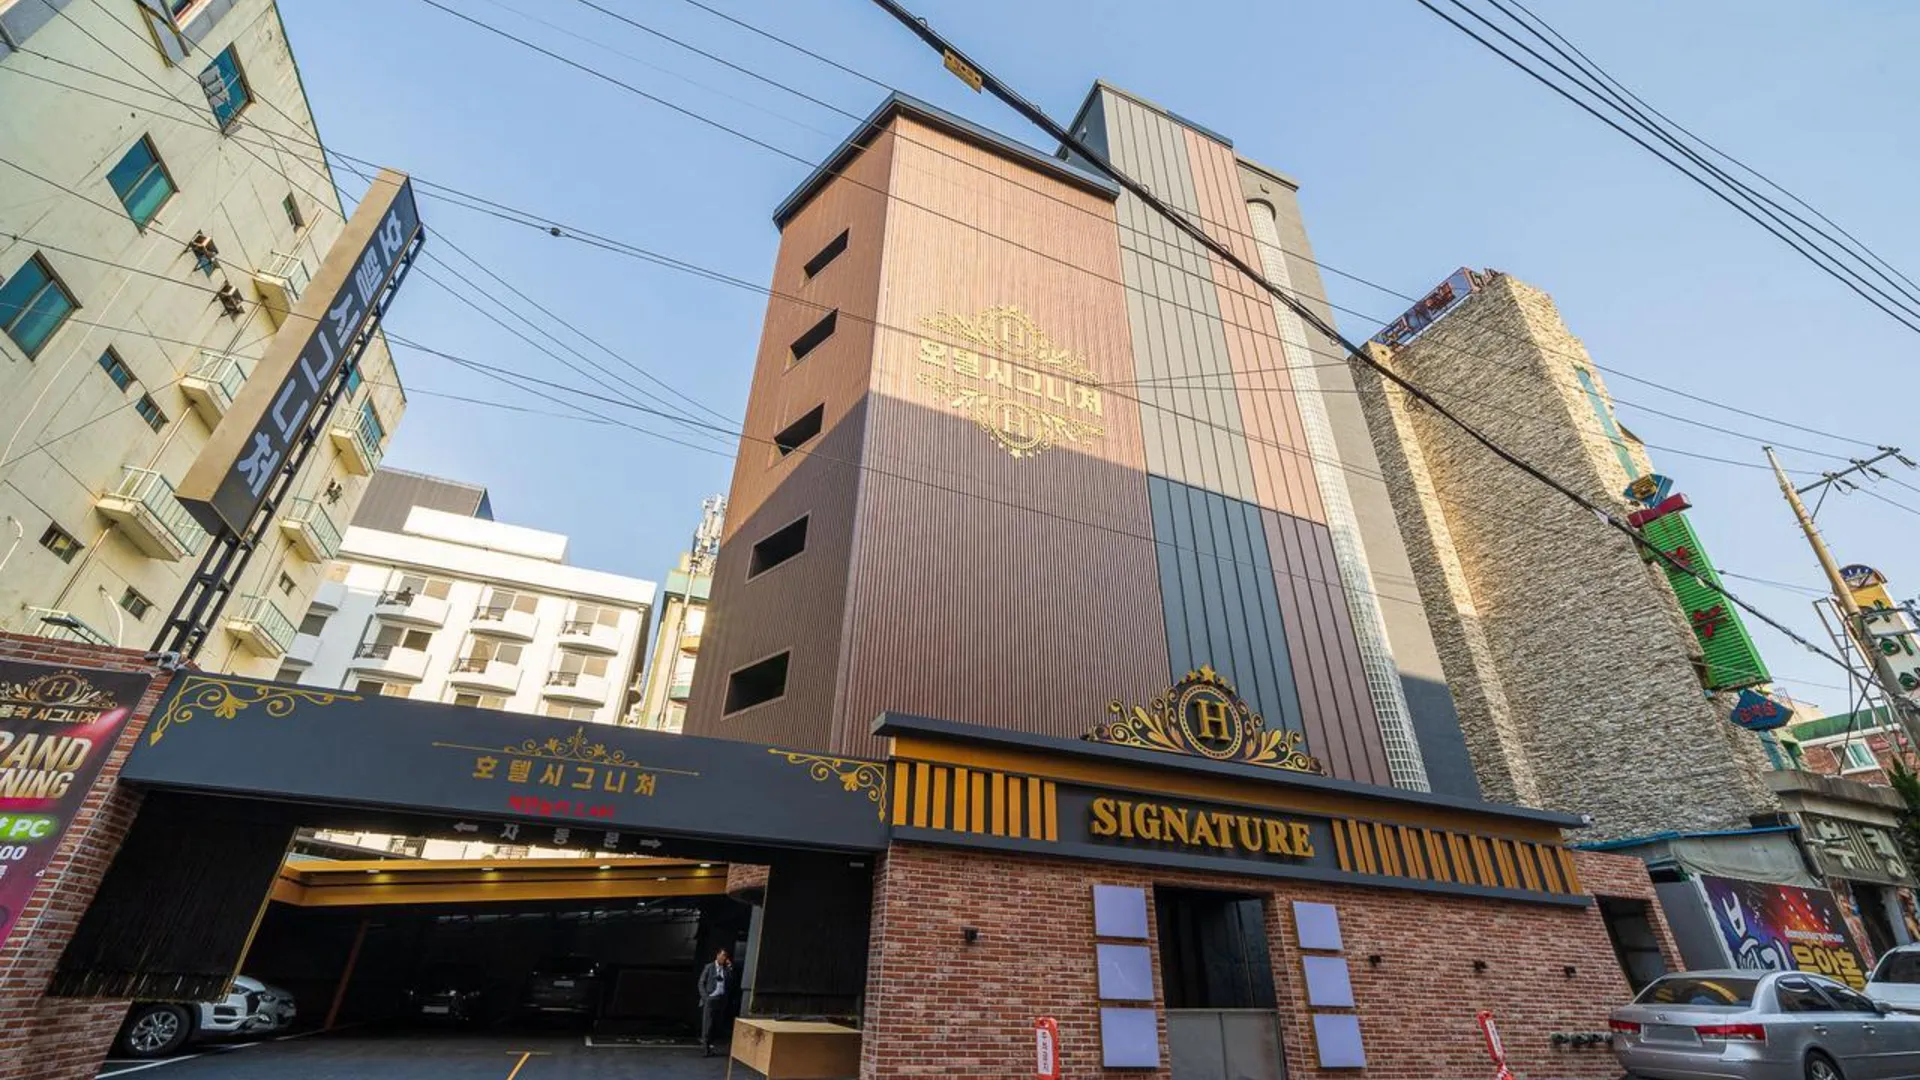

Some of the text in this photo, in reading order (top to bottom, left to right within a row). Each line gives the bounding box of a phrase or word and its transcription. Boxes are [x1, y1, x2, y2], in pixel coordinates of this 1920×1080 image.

[236, 208, 402, 498] 호텔시그니처
[917, 338, 1104, 417] 호텔시그니처
[47, 681, 70, 698] H
[1195, 698, 1232, 743] H
[0, 767, 75, 799] NING
[472, 755, 657, 797] 호텔시그니처
[9, 819, 51, 839] PC
[1091, 797, 1315, 858] SIGNATURE
[0, 845, 28, 861] 00
